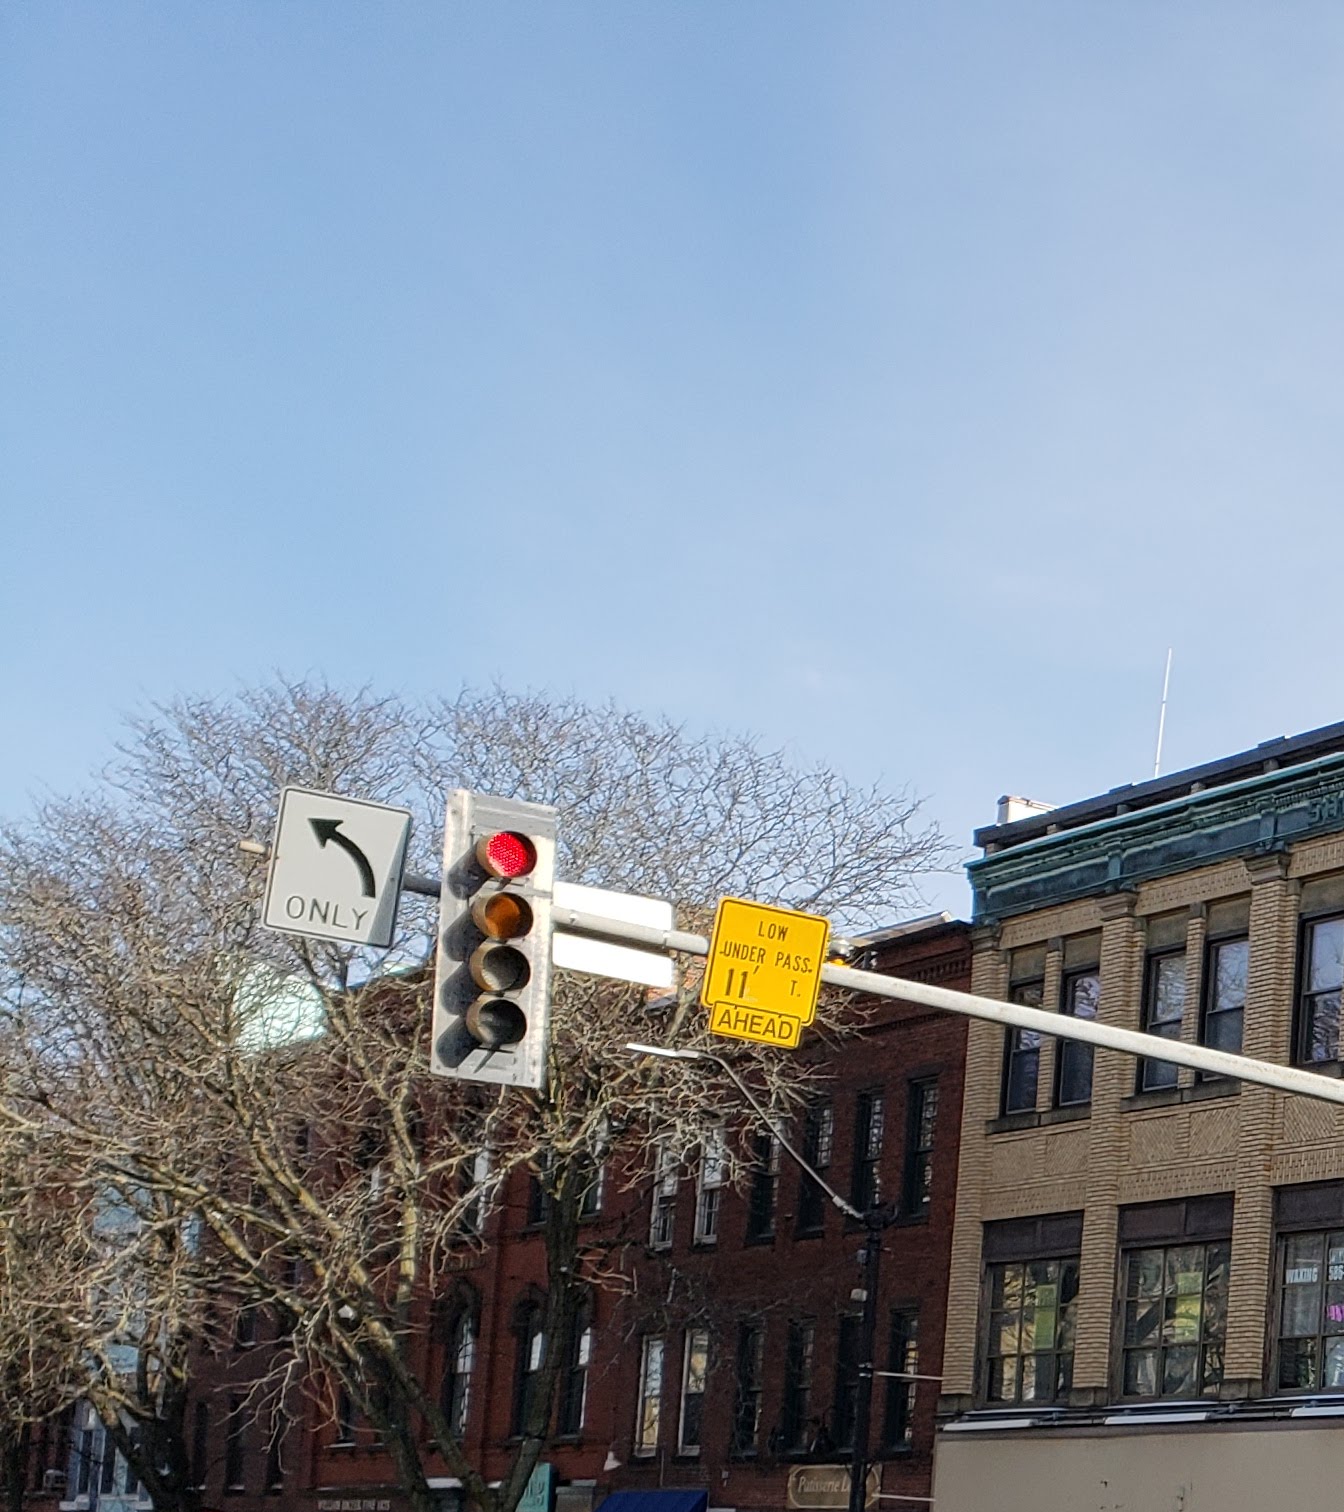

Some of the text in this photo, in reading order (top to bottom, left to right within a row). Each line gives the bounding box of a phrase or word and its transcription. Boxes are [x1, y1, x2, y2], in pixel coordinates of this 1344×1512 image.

[286, 895, 369, 931] ONLY
[758, 920, 789, 942] LOW
[722, 940, 767, 965] UNDER
[717, 1008, 794, 1041] AHEAD
[1286, 1267, 1318, 1284] WAXING
